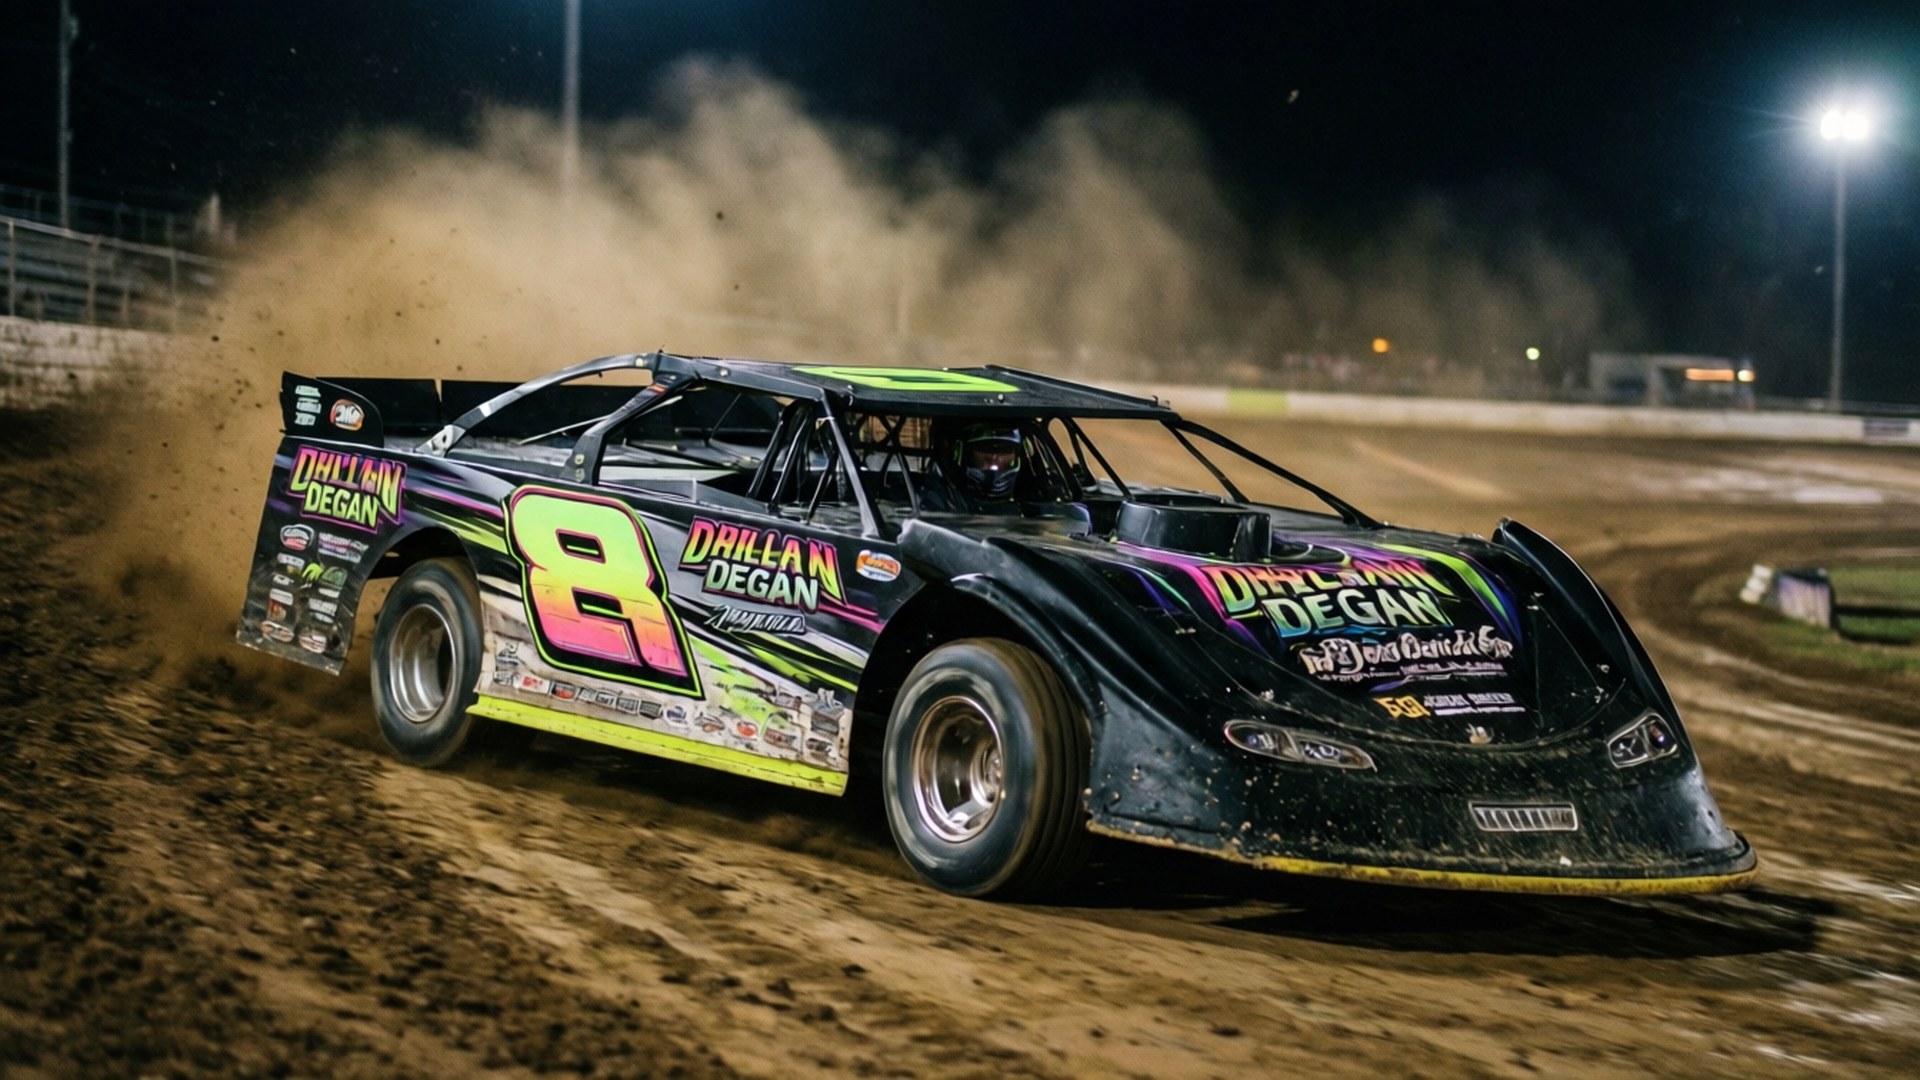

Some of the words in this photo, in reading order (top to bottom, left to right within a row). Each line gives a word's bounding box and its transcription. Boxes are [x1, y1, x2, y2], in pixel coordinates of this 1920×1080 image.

[303, 480, 380, 528] DEGAN
[508, 484, 690, 679] 8
[704, 558, 819, 611] DEGAN
[1262, 588, 1449, 638] DEGAN
